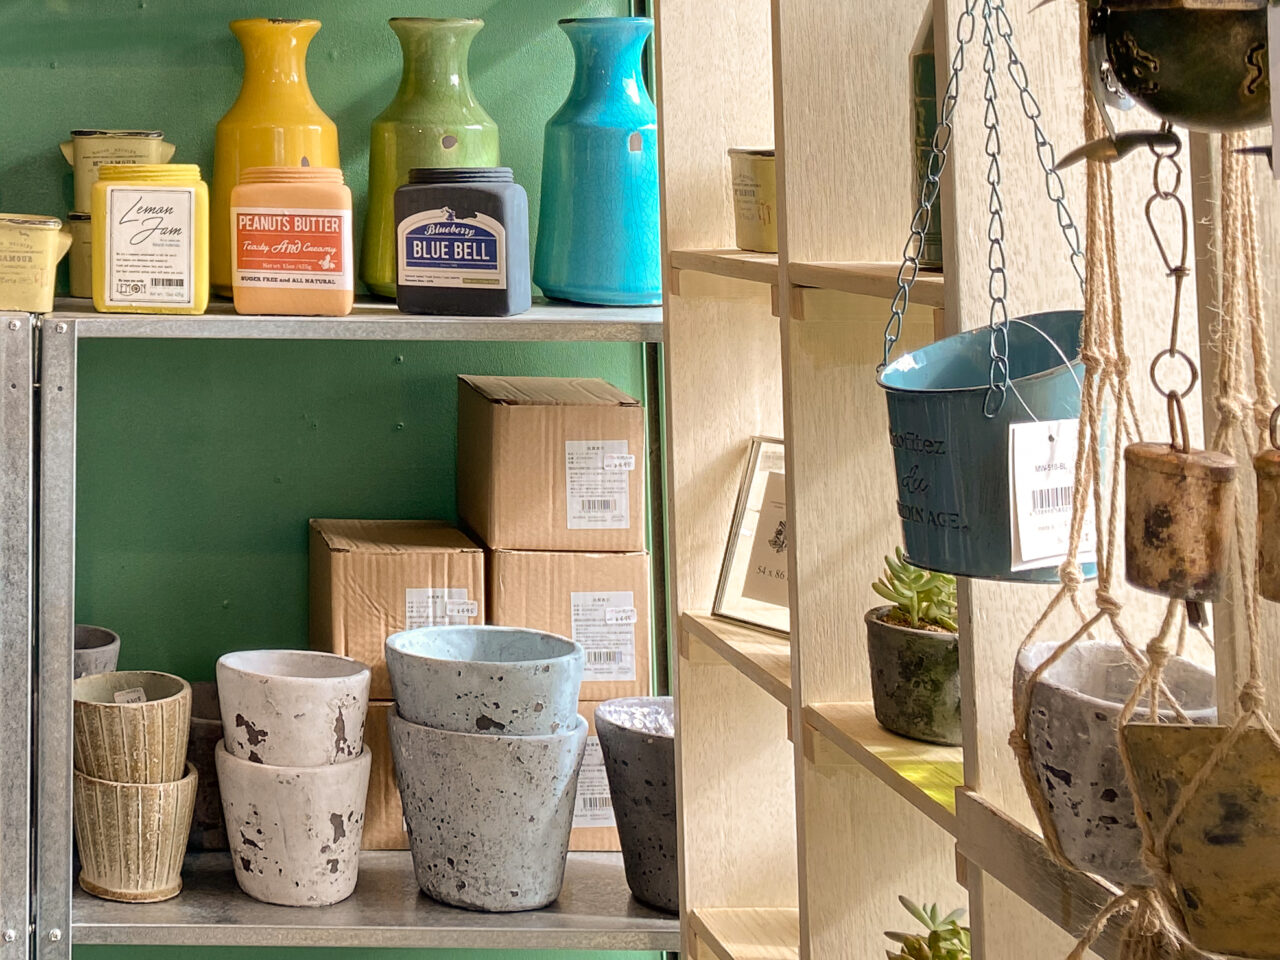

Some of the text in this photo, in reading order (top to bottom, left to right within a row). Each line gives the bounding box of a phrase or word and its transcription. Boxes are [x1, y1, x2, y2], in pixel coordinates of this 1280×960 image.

[119, 195, 174, 225] Lemon
[129, 216, 183, 246] Jam
[239, 215, 340, 233] PEANUTS BUTTER
[424, 223, 476, 238] Blueberry
[412, 240, 490, 260] BLUE BELL
[262, 276, 279, 284] FREE
[756, 565, 767, 576] 54
[774, 569, 786, 580] 86
